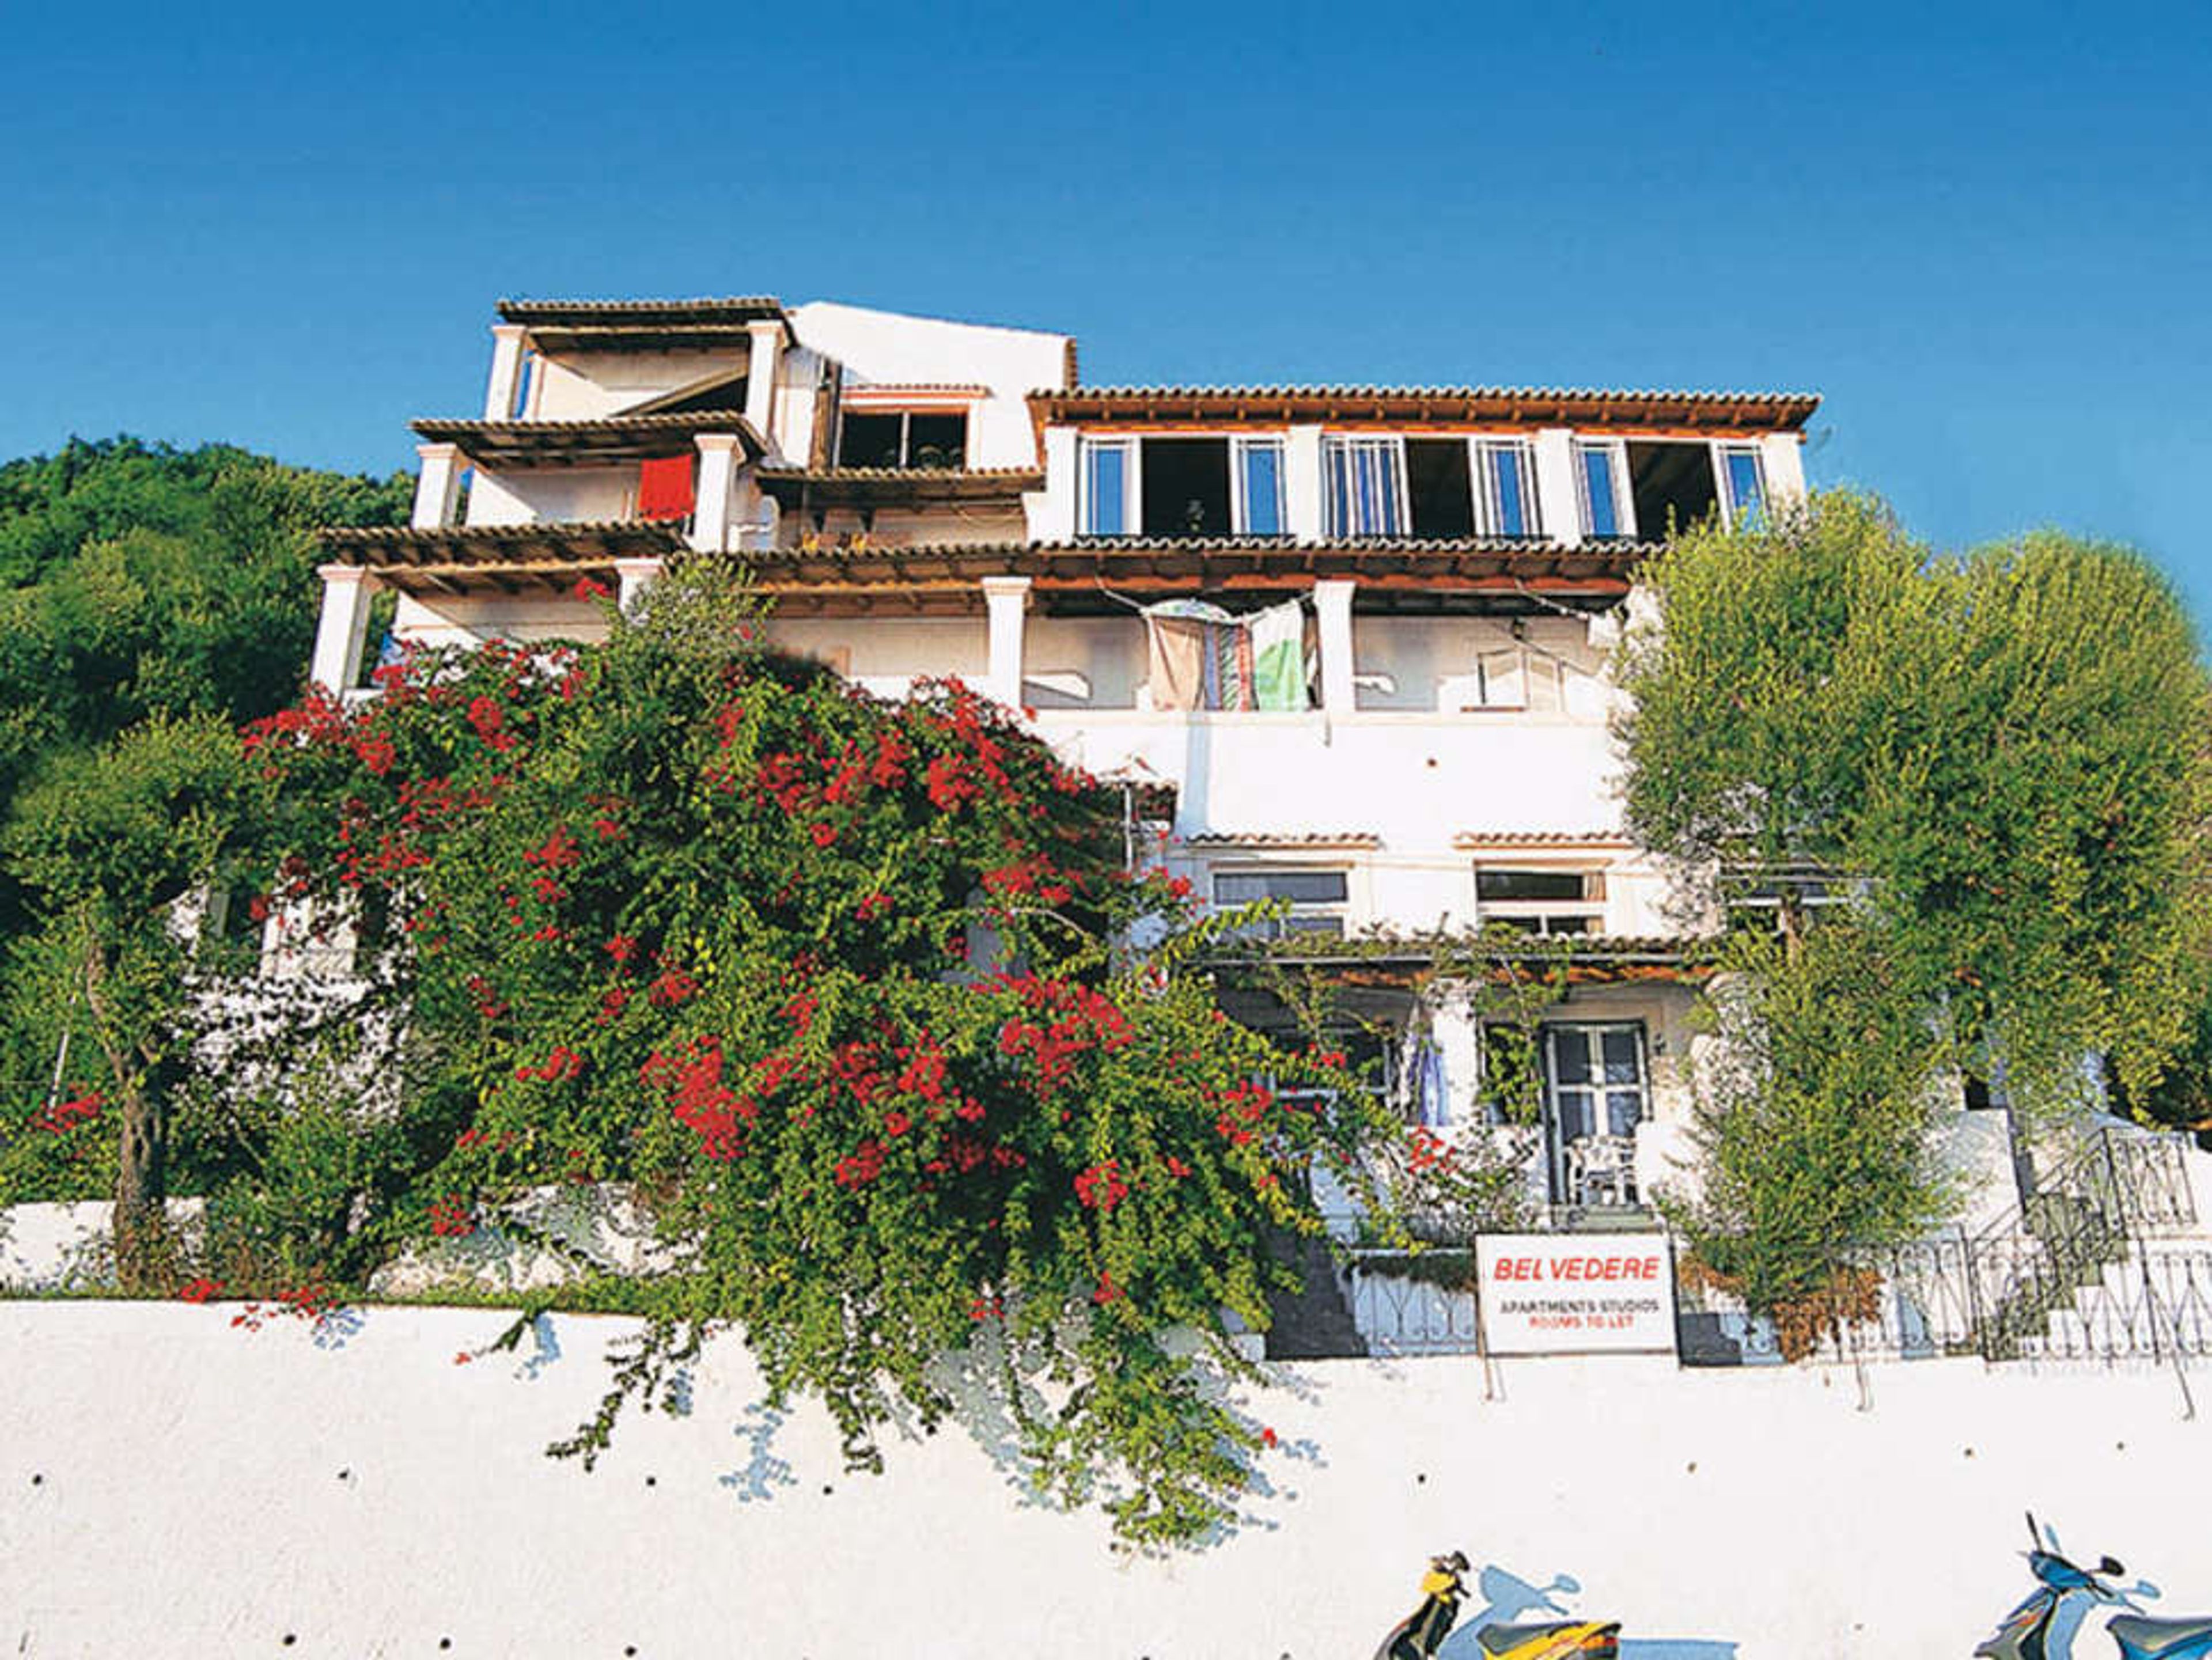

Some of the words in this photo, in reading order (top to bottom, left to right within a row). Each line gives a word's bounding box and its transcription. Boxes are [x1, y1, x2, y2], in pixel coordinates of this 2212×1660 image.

[1501, 1299, 1596, 1313] APARTMENTS
[1600, 1299, 1660, 1313] STUDIOS
[1608, 1316, 1634, 1328] LET
